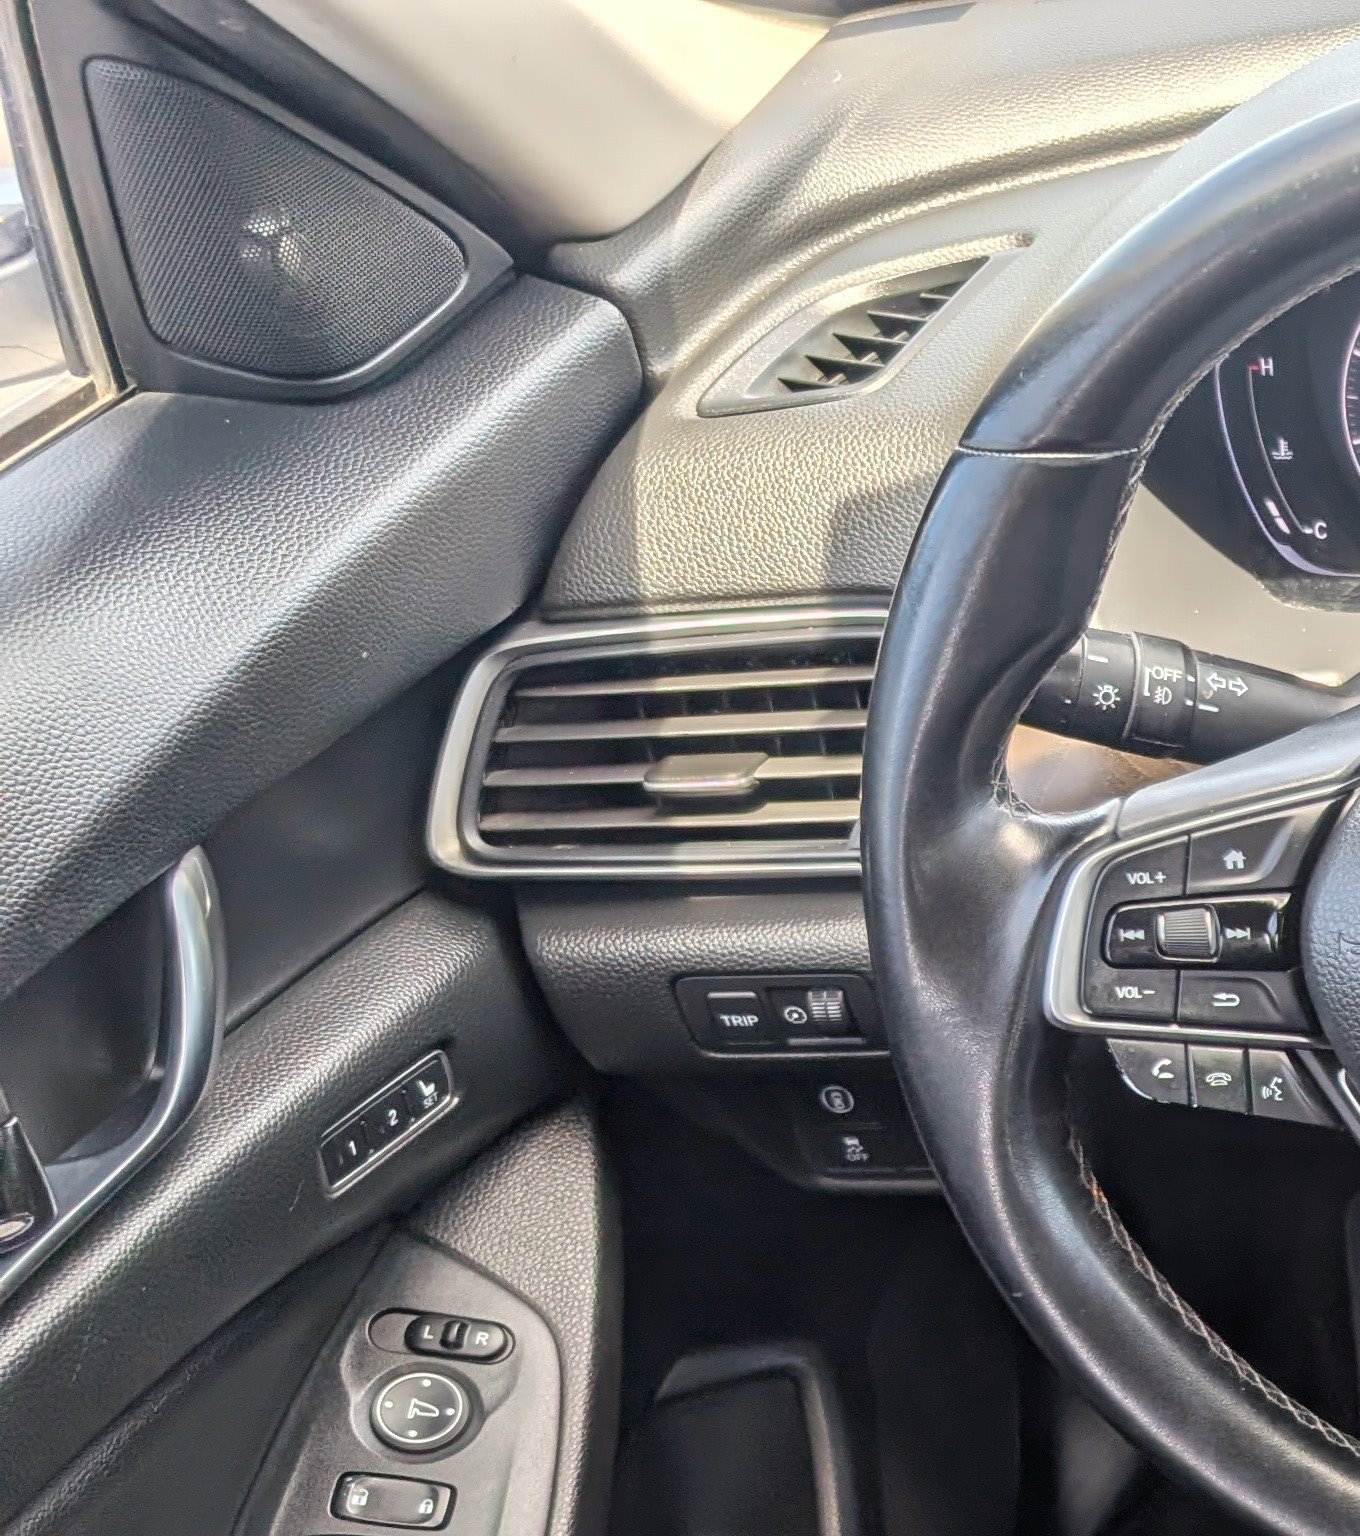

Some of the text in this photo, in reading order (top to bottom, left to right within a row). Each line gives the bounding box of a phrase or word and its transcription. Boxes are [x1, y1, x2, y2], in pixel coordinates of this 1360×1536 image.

[1259, 357, 1274, 377] H
[1313, 519, 1328, 540] C
[1150, 665, 1183, 683] OFF
[720, 1013, 759, 1027] TRIP
[387, 1109, 399, 1127] 2
[348, 1140, 357, 1156] 1
[422, 1325, 490, 1346] L R
